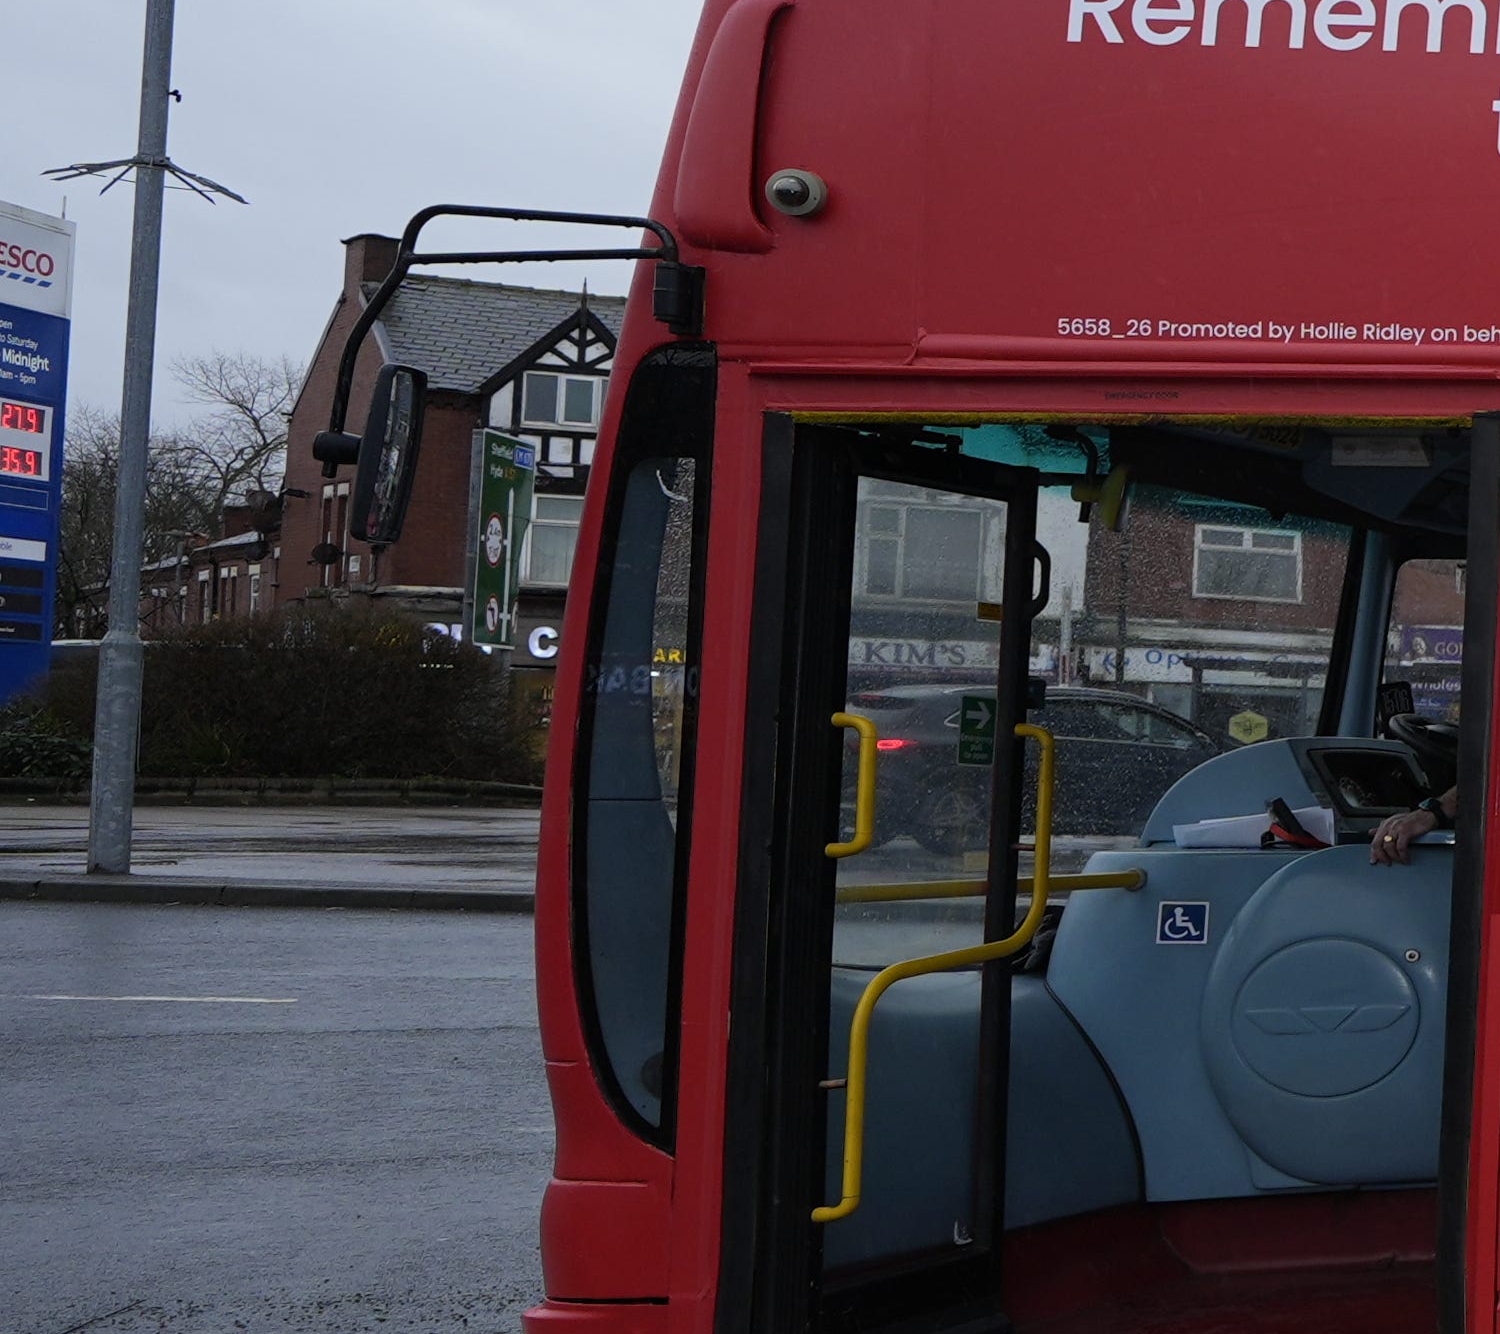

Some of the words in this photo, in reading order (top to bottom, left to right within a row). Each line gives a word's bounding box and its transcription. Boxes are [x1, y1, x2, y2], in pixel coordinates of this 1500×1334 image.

[6, 334, 39, 352] Saturday
[1058, 318, 1151, 344] 5658_26
[1159, 320, 1262, 338] Promoted
[1269, 321, 1295, 345] by
[1301, 322, 1357, 340] Hollie
[1363, 323, 1425, 347] Ridley
[1431, 328, 1458, 342] on
[2, 348, 50, 373] Midnight
[863, 641, 966, 665] KIM'S
